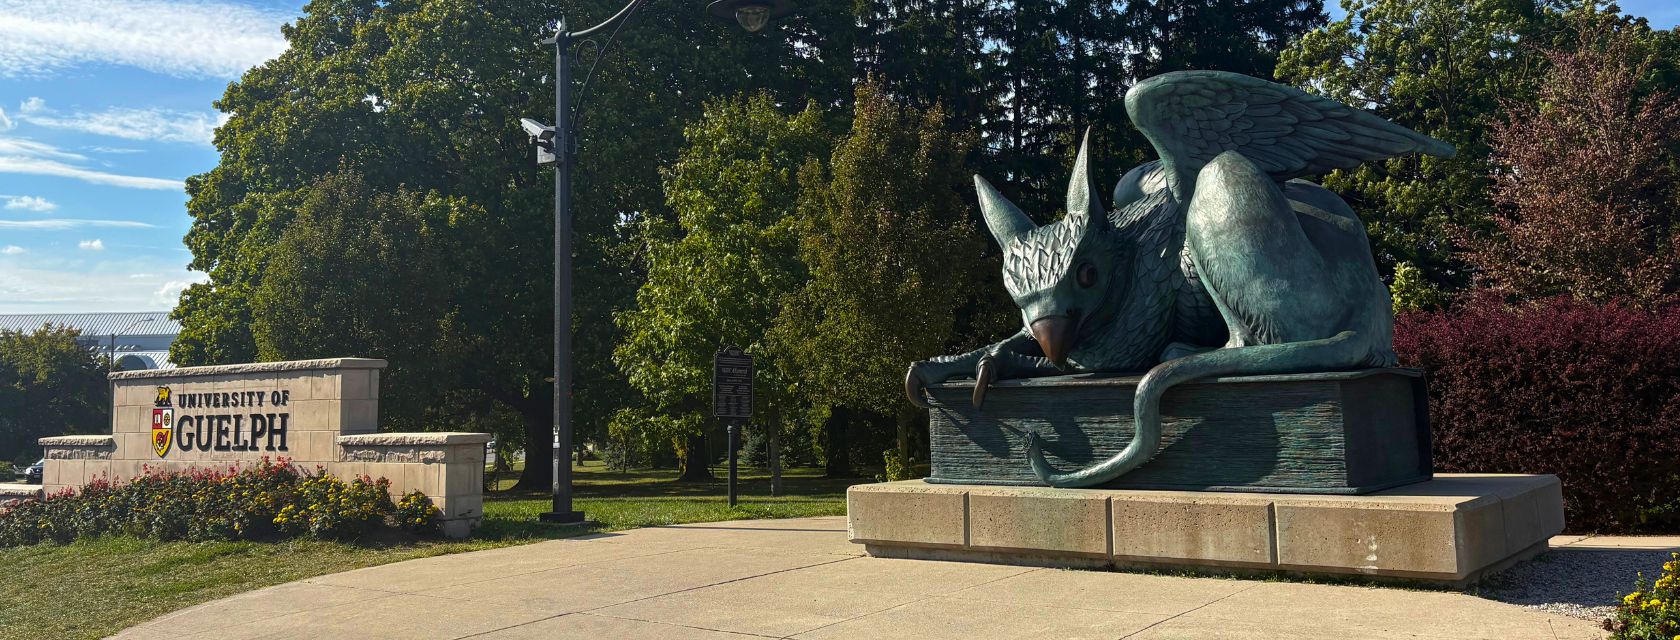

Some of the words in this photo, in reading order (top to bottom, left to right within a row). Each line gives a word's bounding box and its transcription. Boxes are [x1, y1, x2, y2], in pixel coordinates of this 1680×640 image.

[178, 391, 265, 409] UNIVERSITY
[271, 390, 290, 406] OF
[176, 413, 290, 452] GUELPH
